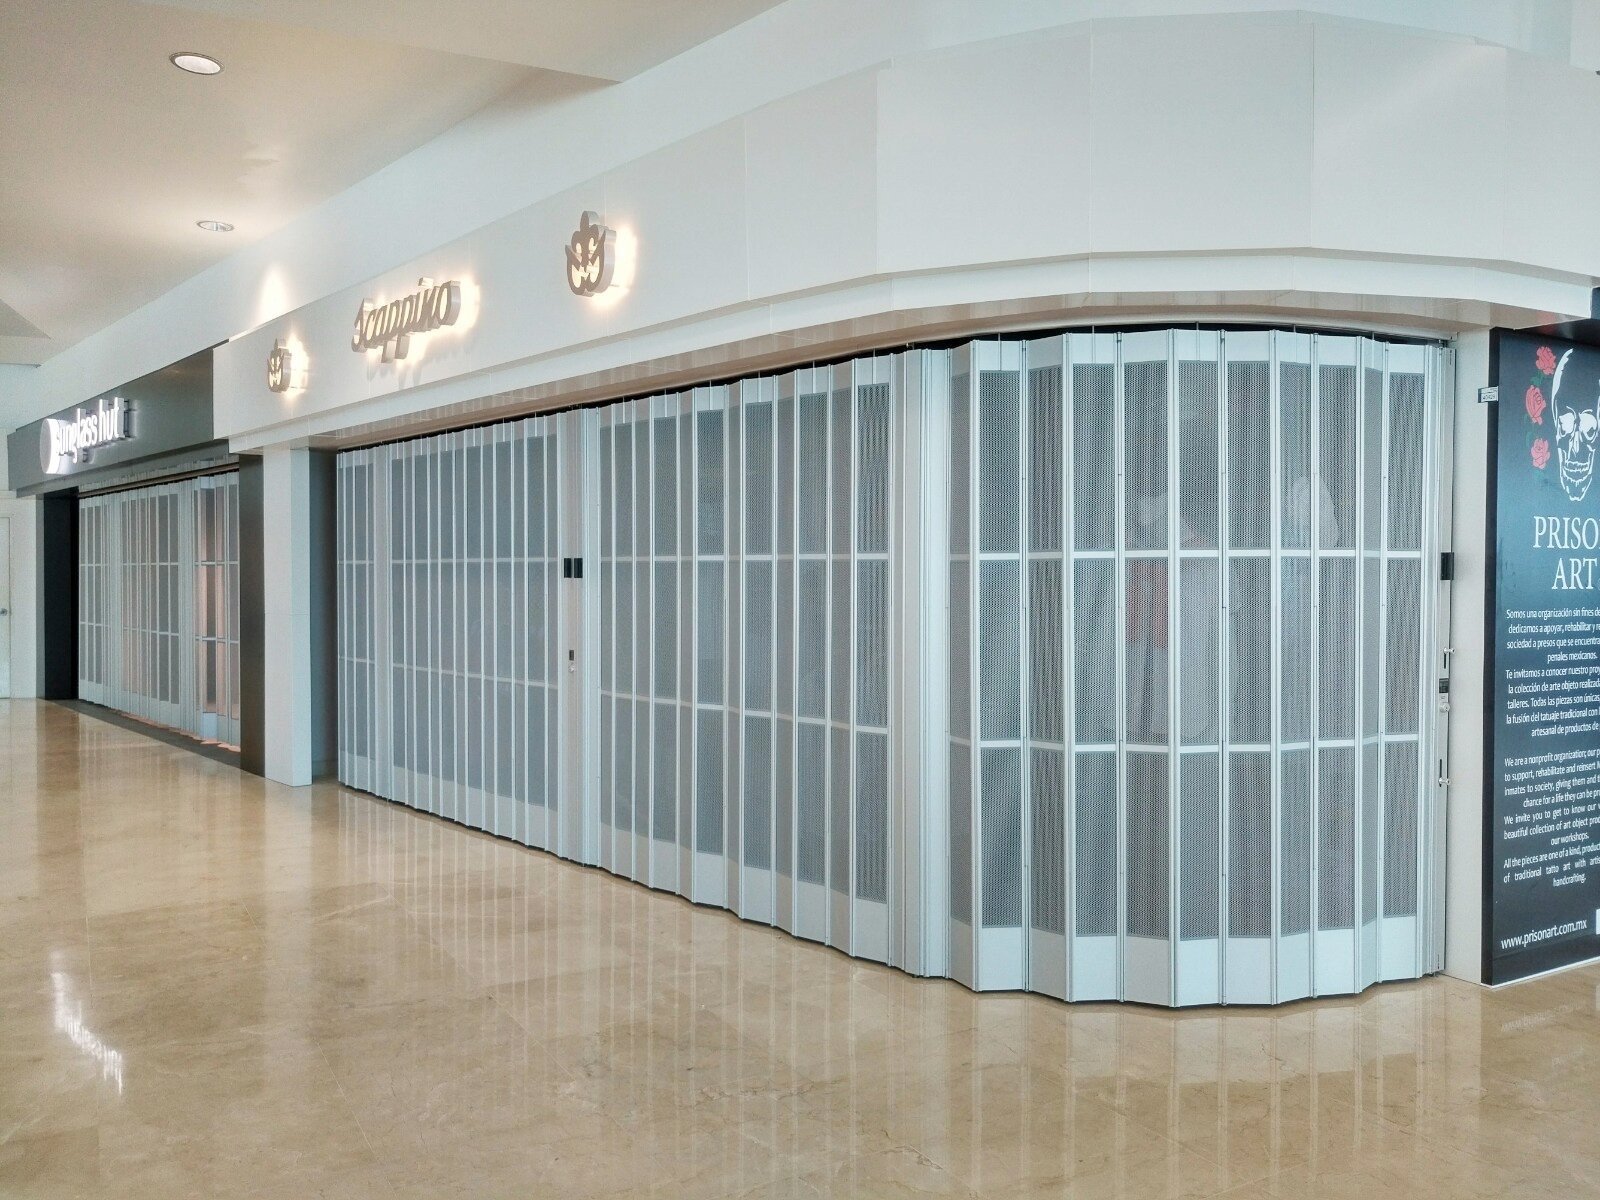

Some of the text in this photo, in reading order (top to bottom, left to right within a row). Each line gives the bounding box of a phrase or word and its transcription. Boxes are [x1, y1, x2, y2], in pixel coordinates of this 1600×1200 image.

[98, 396, 123, 442] hut
[1533, 515, 1600, 550] PRISO
[1551, 557, 1598, 590] ART
[1506, 608, 1526, 618] Somos
[1527, 610, 1537, 618] una
[1538, 608, 1572, 620] organización
[1581, 606, 1594, 616] fines
[1508, 624, 1538, 634] dedicamos
[1544, 624, 1564, 634] apoyar,
[1565, 622, 1591, 632] rehabilitar
[1591, 623, 1595, 633] y
[1507, 638, 1532, 649] sociedad
[1537, 640, 1555, 650] presos
[1556, 639, 1566, 648] que
[1547, 651, 1598, 664] penales mexicanos.
[1506, 670, 1513, 679] Te
[1513, 669, 1540, 678] invitamos
[1546, 668, 1567, 676] conocer
[1568, 666, 1588, 675] nuestro
[1508, 684, 1513, 694] la
[1514, 682, 1540, 693] colección
[1541, 682, 1548, 691] de
[1549, 683, 1560, 691] arte
[1561, 680, 1578, 692] objeto
[1507, 699, 1529, 709] talleres.
[1531, 697, 1546, 707] Todas
[1556, 696, 1572, 707] piezas
[1506, 715, 1511, 724] la
[1512, 713, 1530, 723] fusión
[1531, 712, 1539, 722] del
[1540, 710, 1559, 722] tatuaje
[1560, 708, 1588, 720] tradicional
[1531, 721, 1598, 737] artesanal de productos de
[1505, 758, 1514, 767] We
[1514, 758, 1523, 766] are
[1528, 752, 1553, 765] nonprofit
[1505, 774, 1511, 782] to
[1512, 770, 1534, 782] support,
[1536, 766, 1565, 778] rehabilitate
[1566, 764, 1575, 774] and
[1577, 761, 1596, 771] reinsert
[1505, 786, 1526, 796] inmates
[1527, 785, 1533, 793] to
[1534, 782, 1554, 792] society,
[1556, 780, 1571, 792] giving
[1572, 777, 1585, 786] them
[1586, 774, 1596, 784] and
[1523, 798, 1542, 807] chance
[1542, 795, 1551, 804] for
[1556, 792, 1564, 803] life
[1564, 792, 1576, 802] they
[1576, 791, 1585, 799] can
[1586, 788, 1592, 798] be
[1504, 816, 1513, 825] We
[1515, 813, 1530, 823] invite
[1532, 813, 1542, 823] you
[1544, 811, 1550, 819] to
[1552, 808, 1561, 820] get
[1571, 805, 1585, 814] know
[1504, 827, 1528, 840] beautiful
[1530, 823, 1554, 836] collection
[1556, 821, 1562, 831] of
[1572, 817, 1588, 828] object
[1561, 832, 1589, 843] workshops.
[1512, 857, 1521, 867] the
[1522, 855, 1538, 867] pieces
[1559, 848, 1565, 858] of
[1569, 846, 1581, 856] kind,
[1504, 873, 1510, 883] of
[1515, 867, 1542, 880] traditional
[1546, 865, 1559, 874] tatto
[1563, 862, 1571, 871] art
[1575, 859, 1586, 868] with
[1553, 873, 1586, 887] handcrafting.
[1501, 920, 1587, 949] www.prisonart.com.mx
